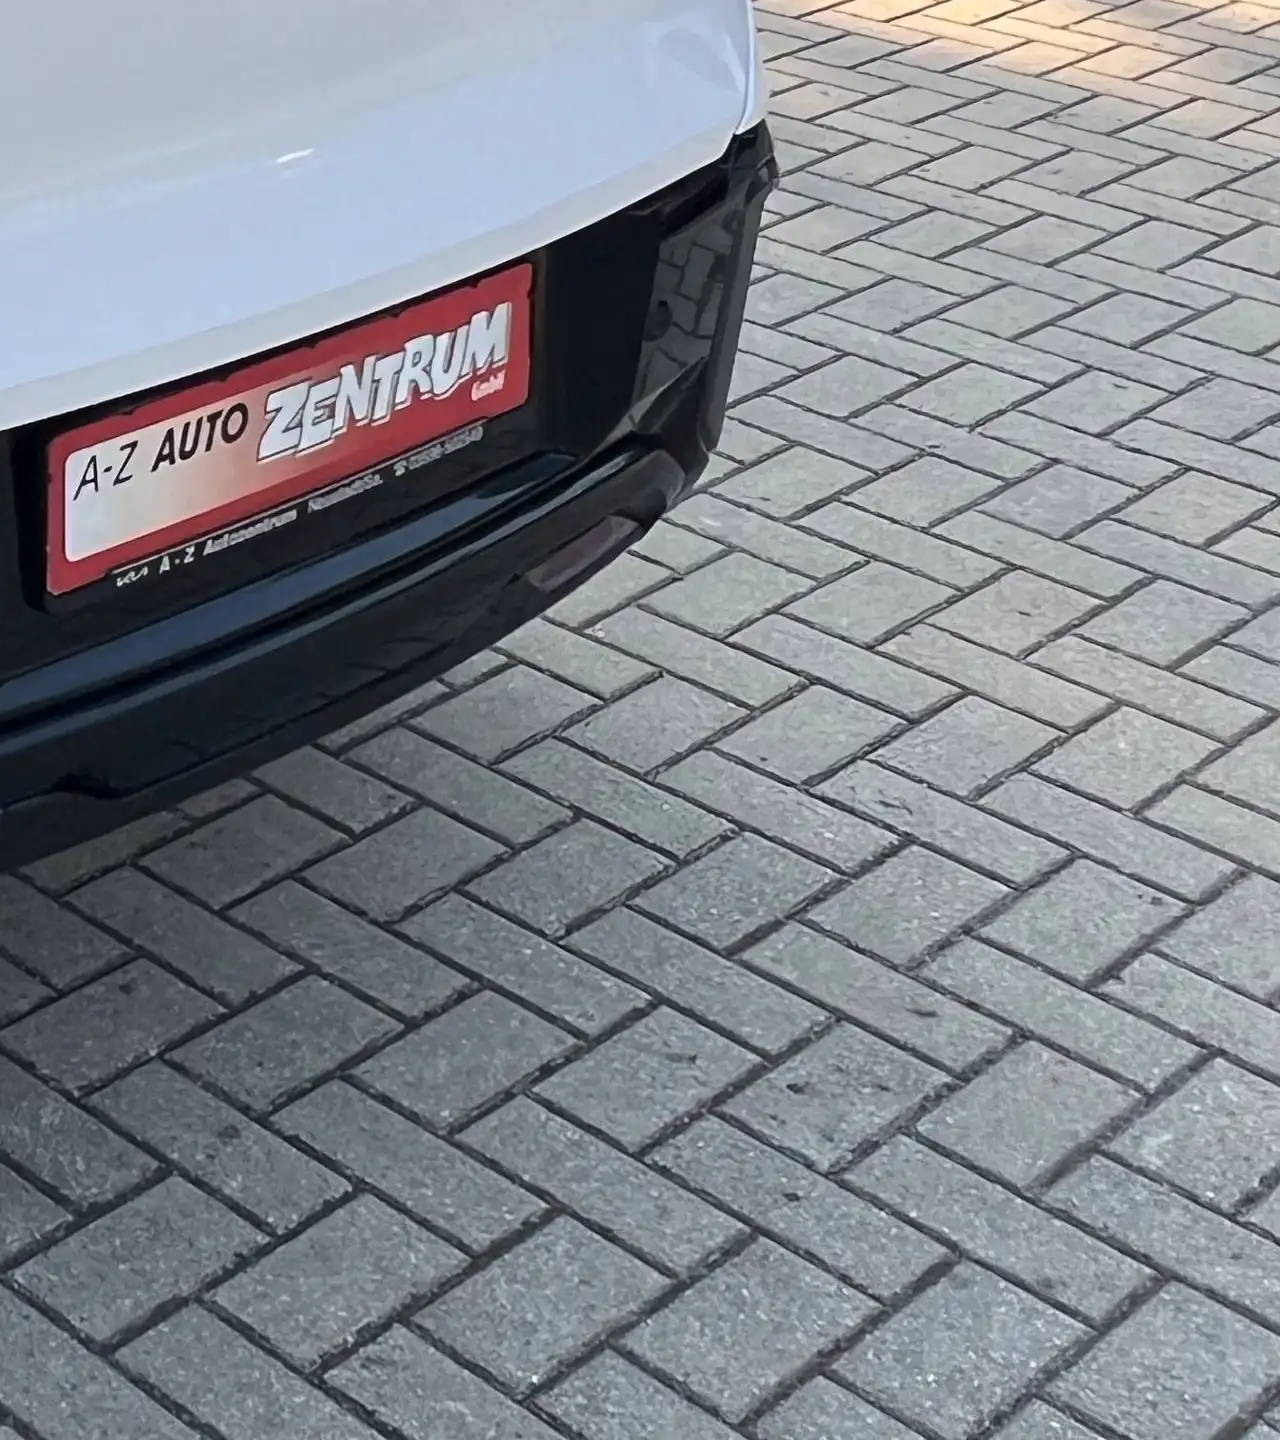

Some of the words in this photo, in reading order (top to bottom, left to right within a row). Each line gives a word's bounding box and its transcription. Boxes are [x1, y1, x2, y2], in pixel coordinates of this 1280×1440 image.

[72, 440, 141, 501] A-Z
[150, 402, 249, 473] AUTO
[255, 301, 513, 463] ZENTRUM
